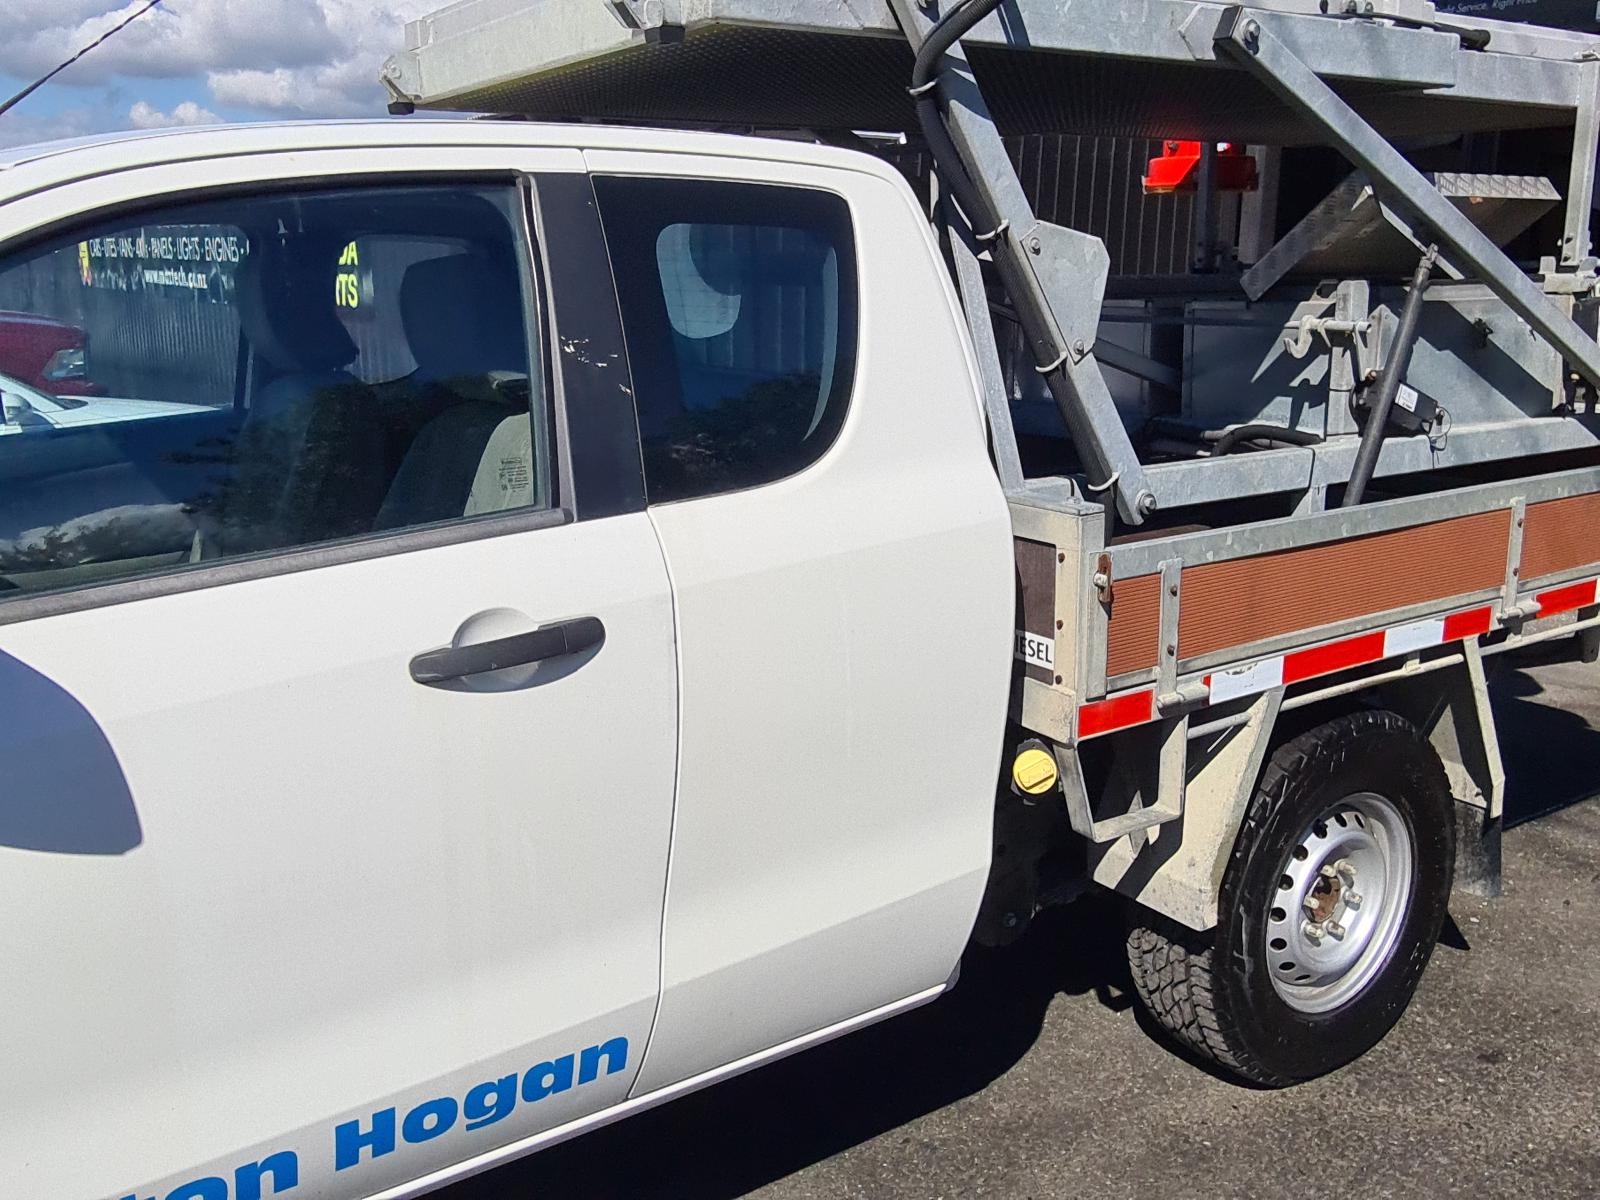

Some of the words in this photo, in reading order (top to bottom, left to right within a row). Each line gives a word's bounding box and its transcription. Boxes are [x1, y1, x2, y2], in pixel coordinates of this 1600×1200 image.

[177, 237, 200, 261] LIGHTS
[205, 237, 239, 262] ENGINES
[334, 1036, 629, 1171] Hogan
